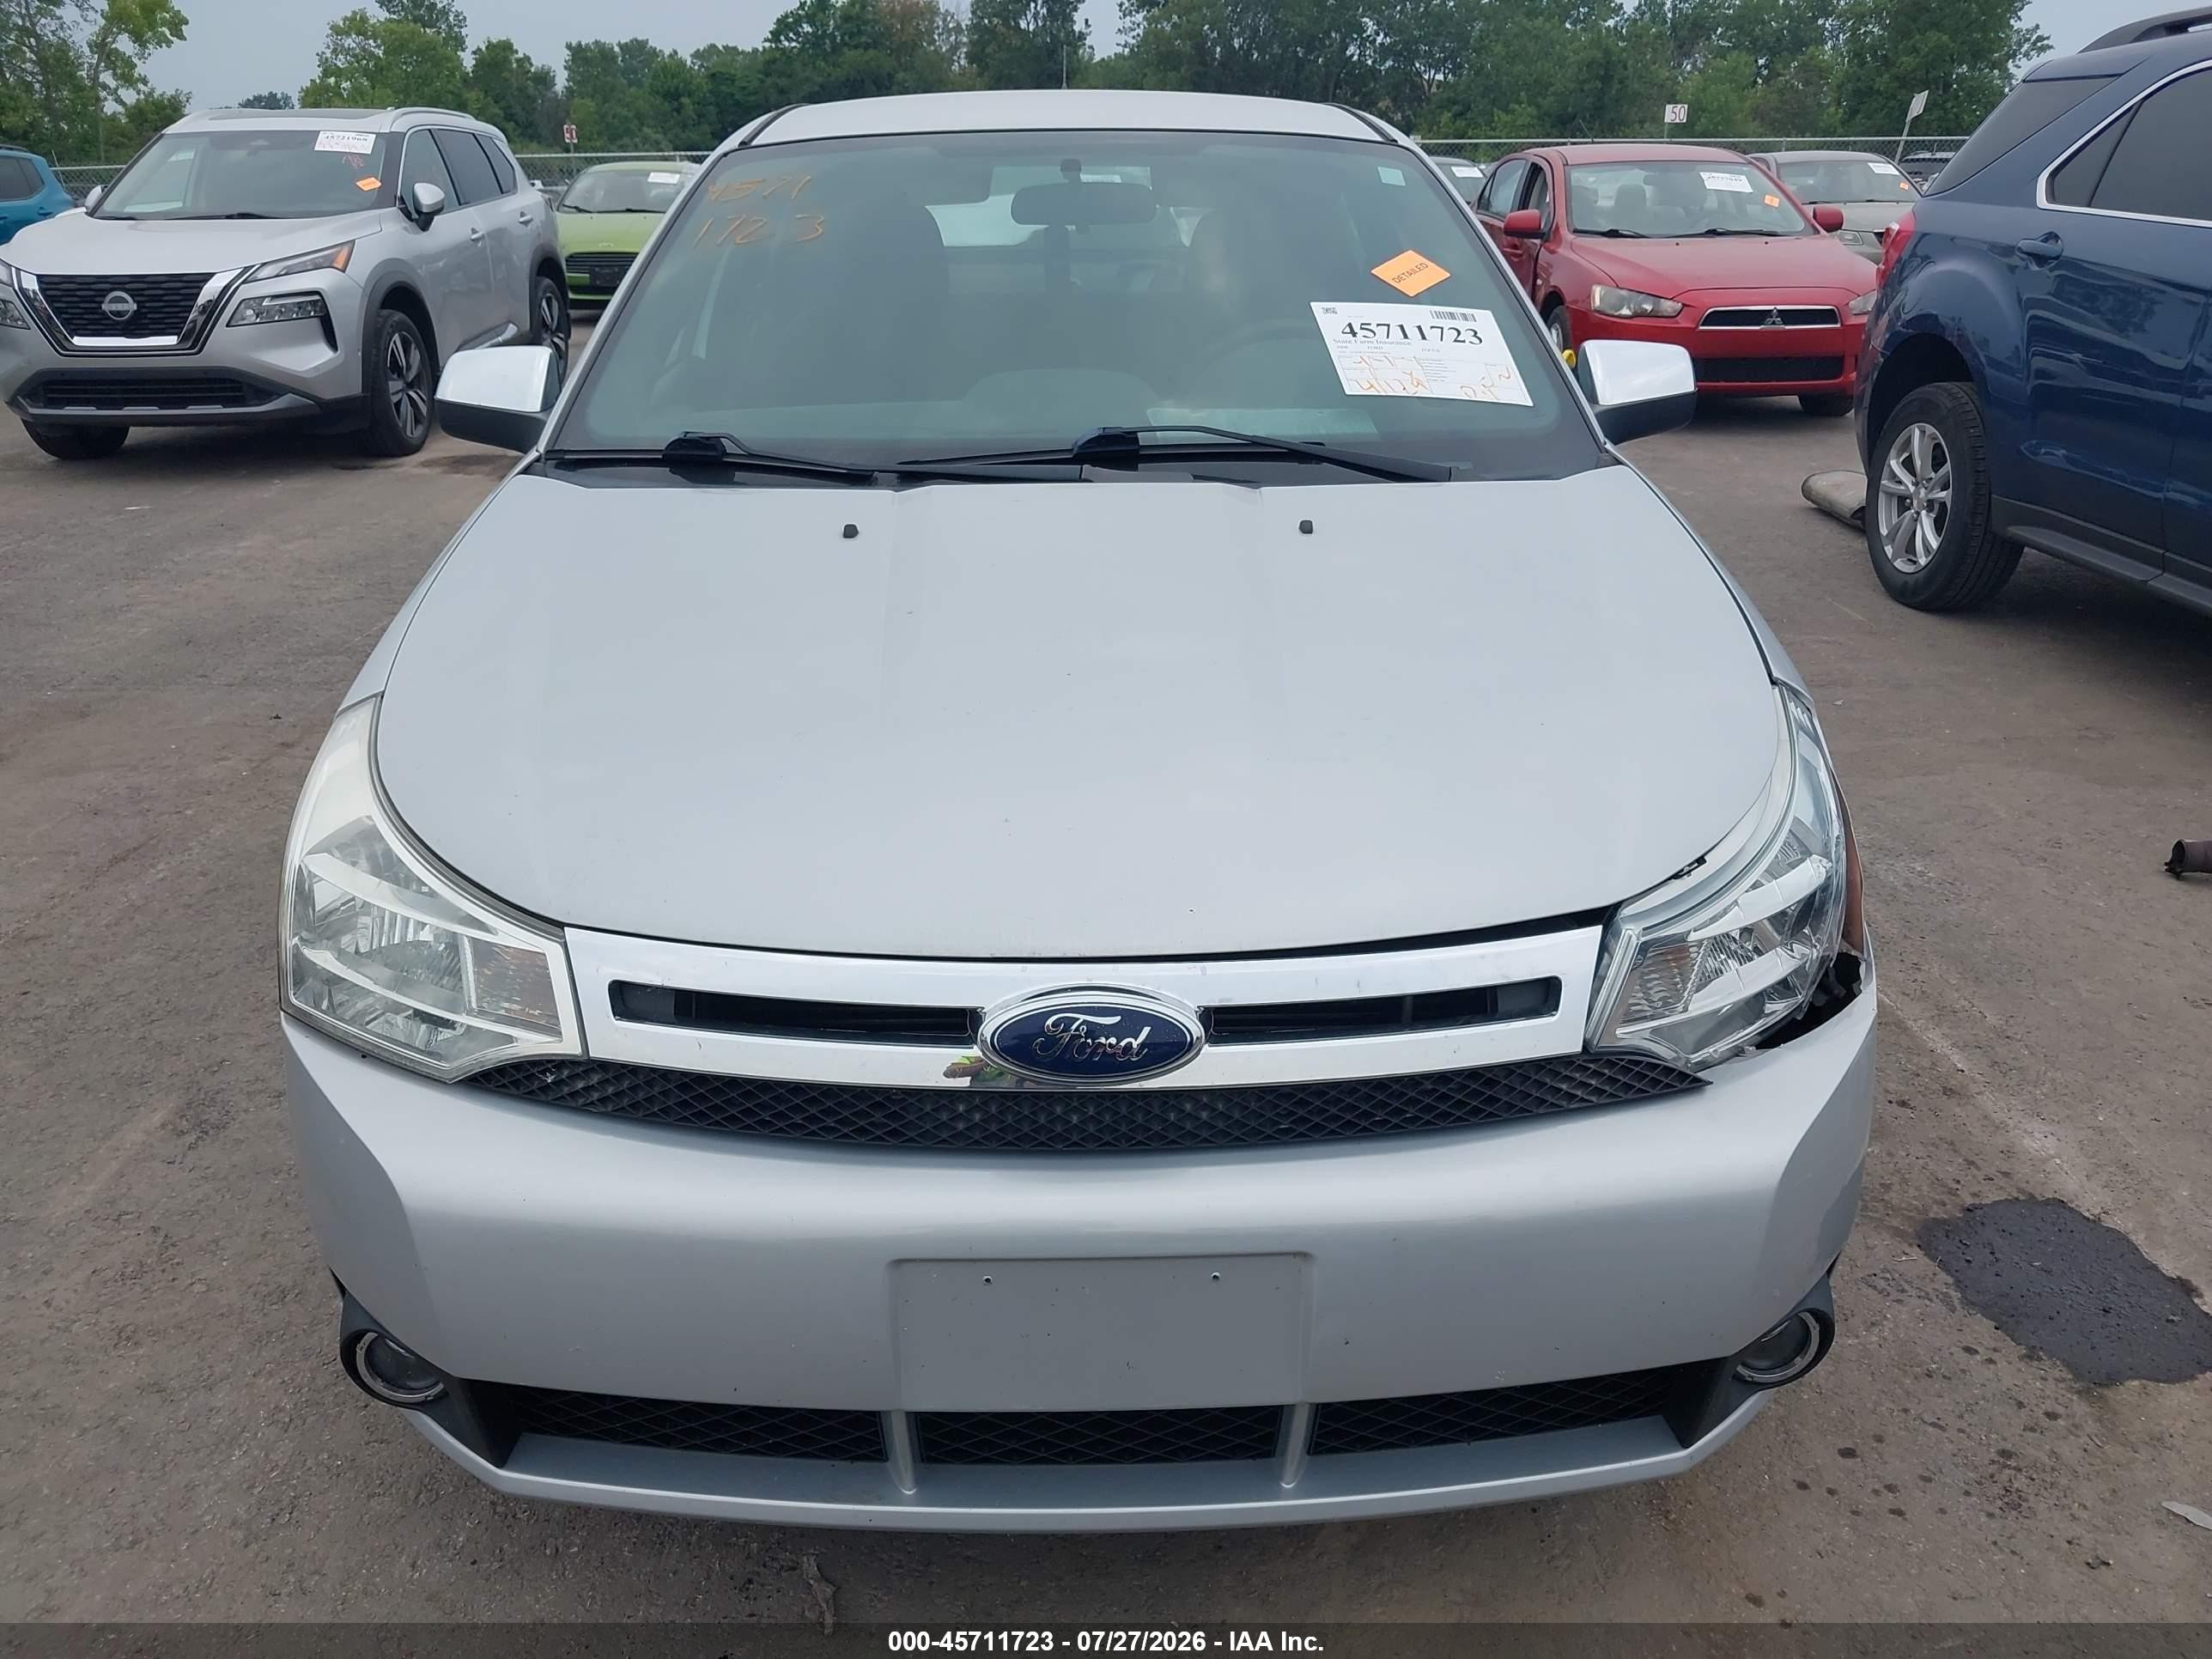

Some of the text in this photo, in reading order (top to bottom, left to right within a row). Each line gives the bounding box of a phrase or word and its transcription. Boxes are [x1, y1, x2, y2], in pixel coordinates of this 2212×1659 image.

[1670, 106, 1686, 122] 50
[708, 175, 811, 206] 4571
[1391, 262, 1429, 283] DETAILED
[1341, 322, 1483, 345] 45711723
[1033, 1012, 1152, 1061] Ford
